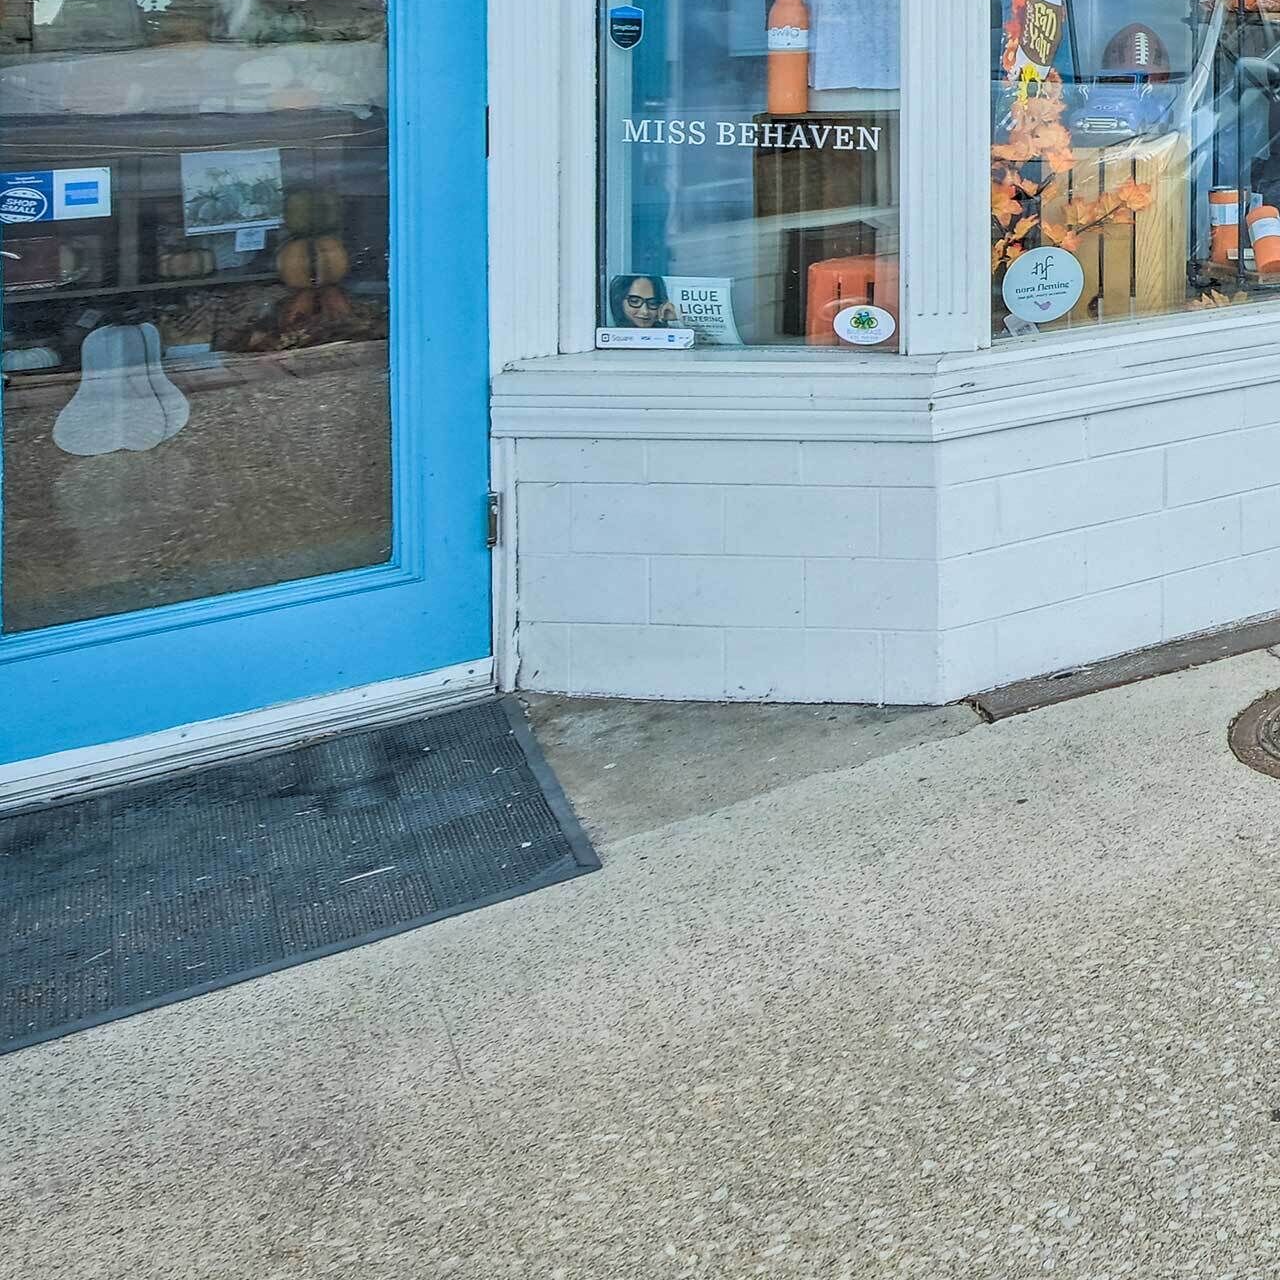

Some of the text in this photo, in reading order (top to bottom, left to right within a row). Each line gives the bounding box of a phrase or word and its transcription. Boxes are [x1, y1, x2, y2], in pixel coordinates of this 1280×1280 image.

[622, 119, 882, 152] MISS BEHAVEN
[6, 198, 38, 207] SHOP
[0, 205, 37, 215] SMALL
[1015, 286, 1035, 294] nora
[681, 290, 718, 302] BLUE
[680, 303, 722, 315] LIGHT
